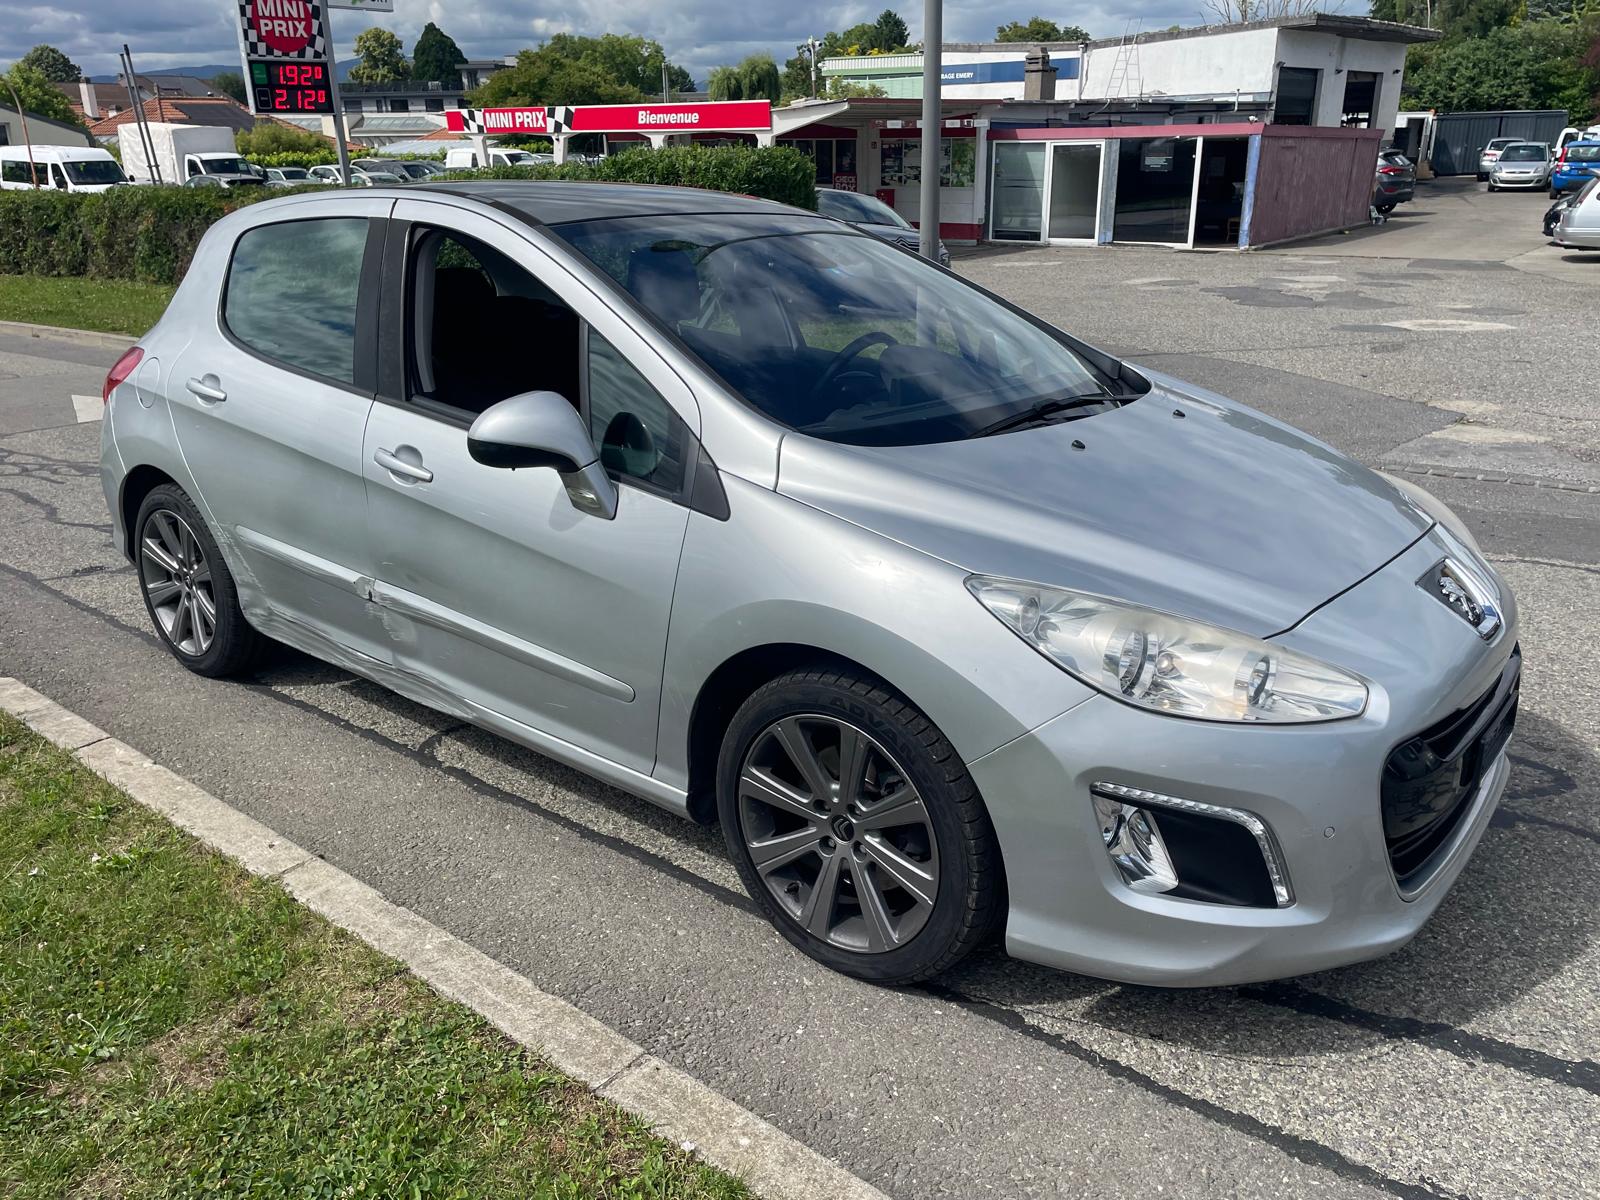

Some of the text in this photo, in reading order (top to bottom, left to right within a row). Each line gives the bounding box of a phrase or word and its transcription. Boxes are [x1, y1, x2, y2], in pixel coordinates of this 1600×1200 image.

[257, 0, 305, 18] MINI
[259, 19, 308, 38] PRIX
[485, 111, 546, 128] MINI PRIX
[638, 110, 700, 124] Bienvenue
